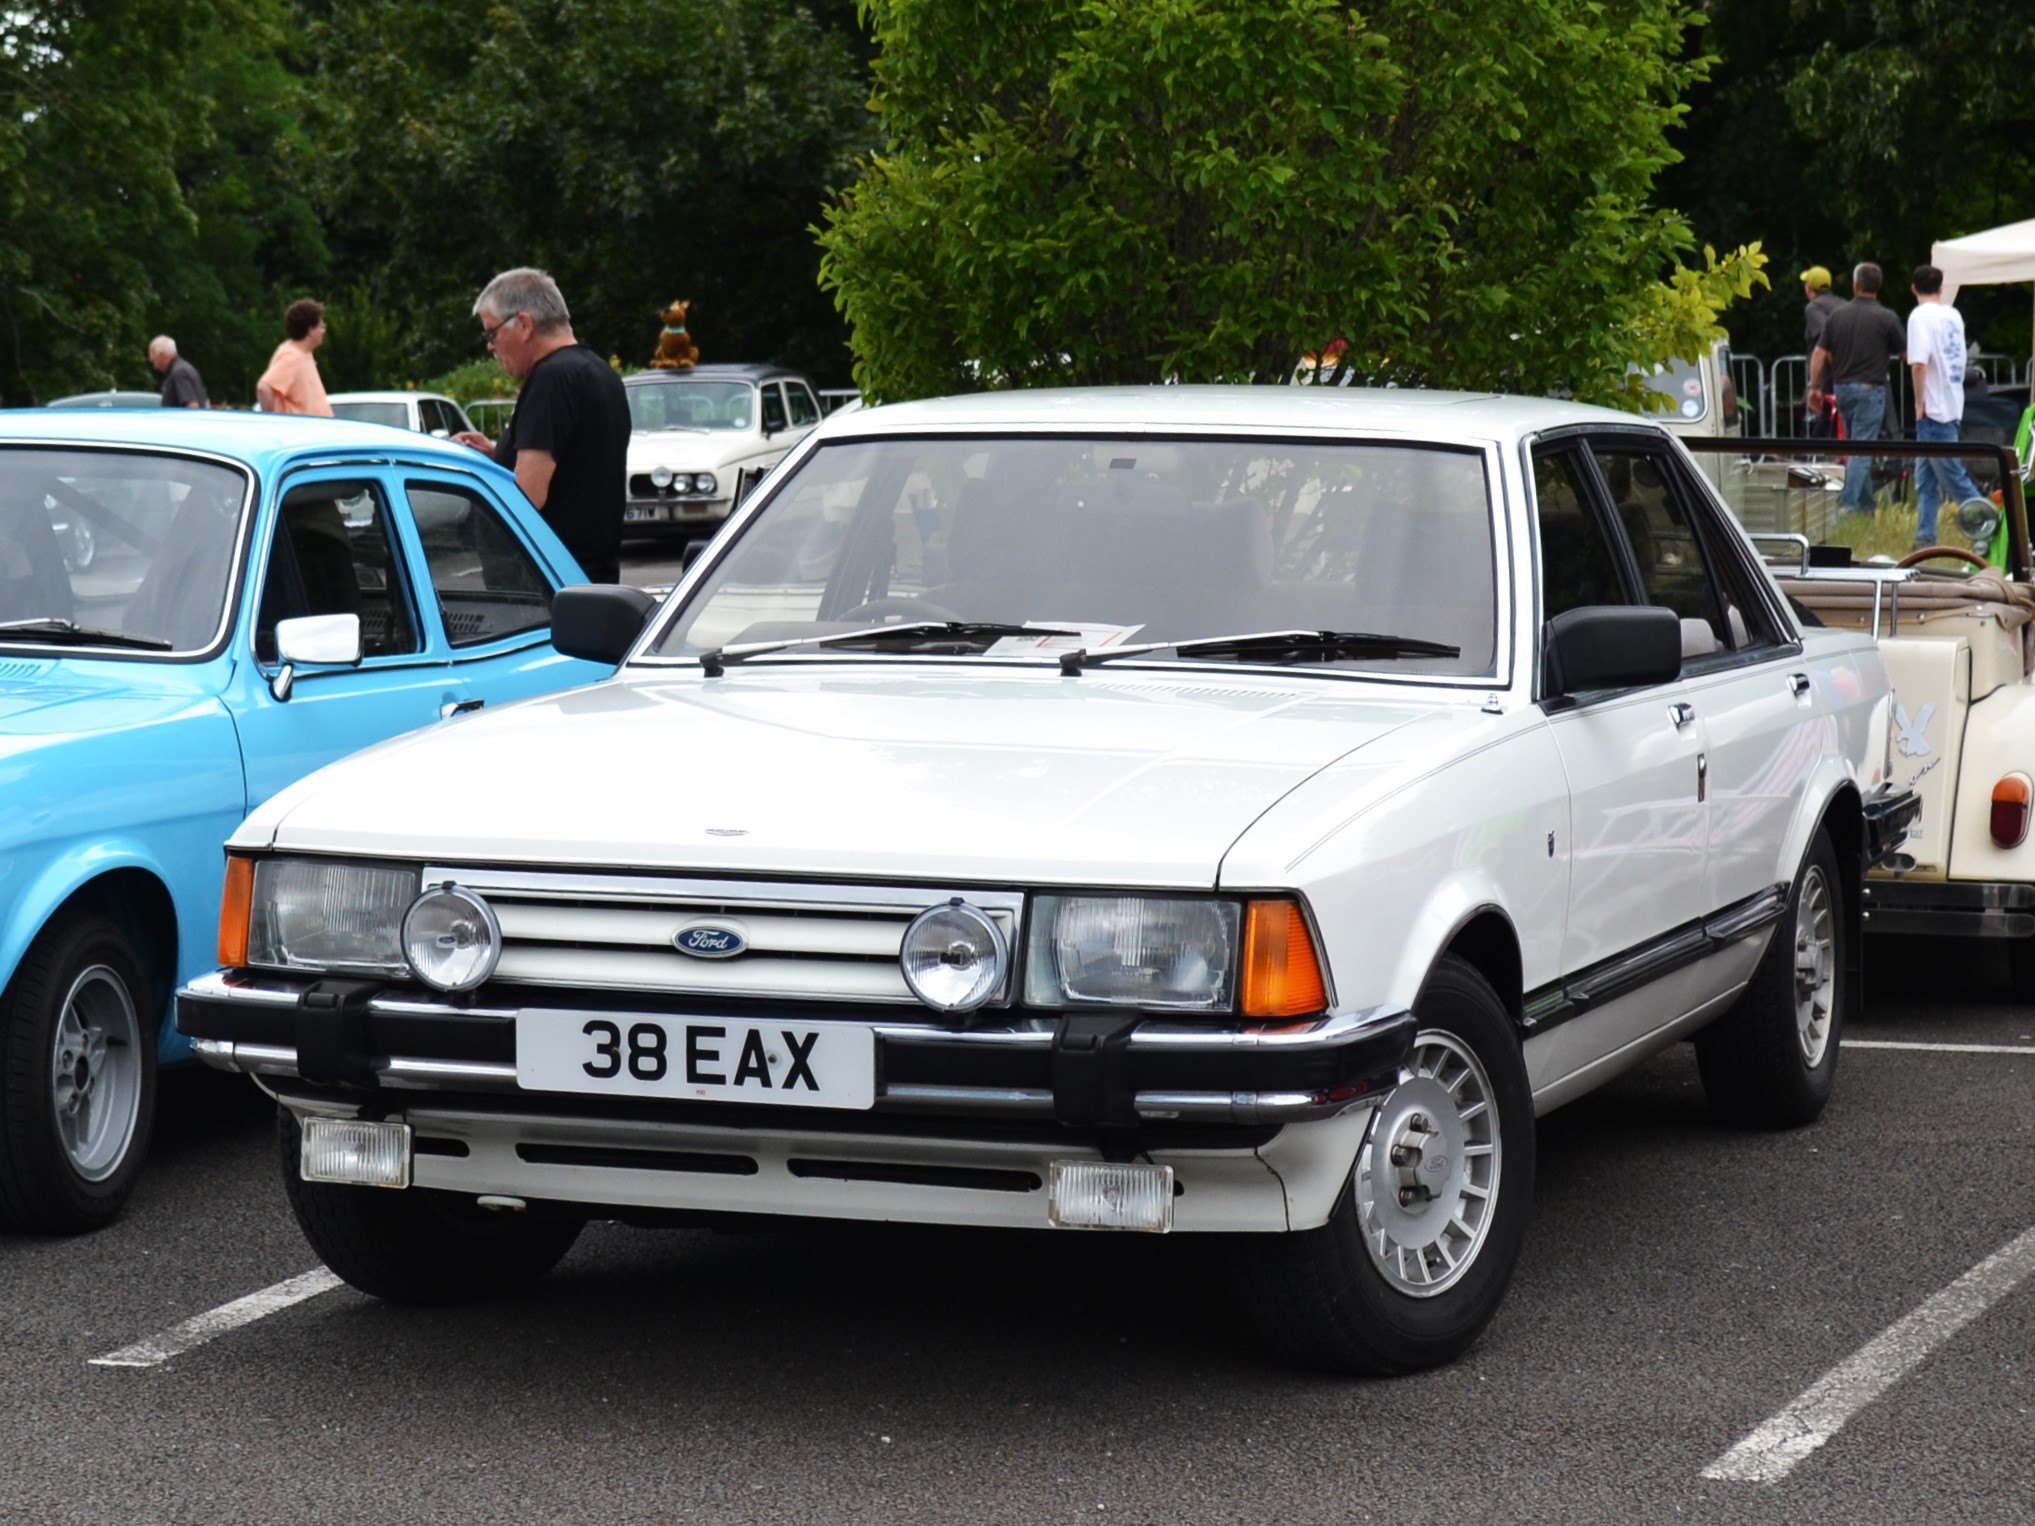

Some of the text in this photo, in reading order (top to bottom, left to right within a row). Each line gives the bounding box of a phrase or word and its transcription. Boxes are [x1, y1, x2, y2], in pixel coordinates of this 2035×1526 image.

[688, 930, 729, 949] Ford
[582, 1020, 820, 1092] 38 EAX
